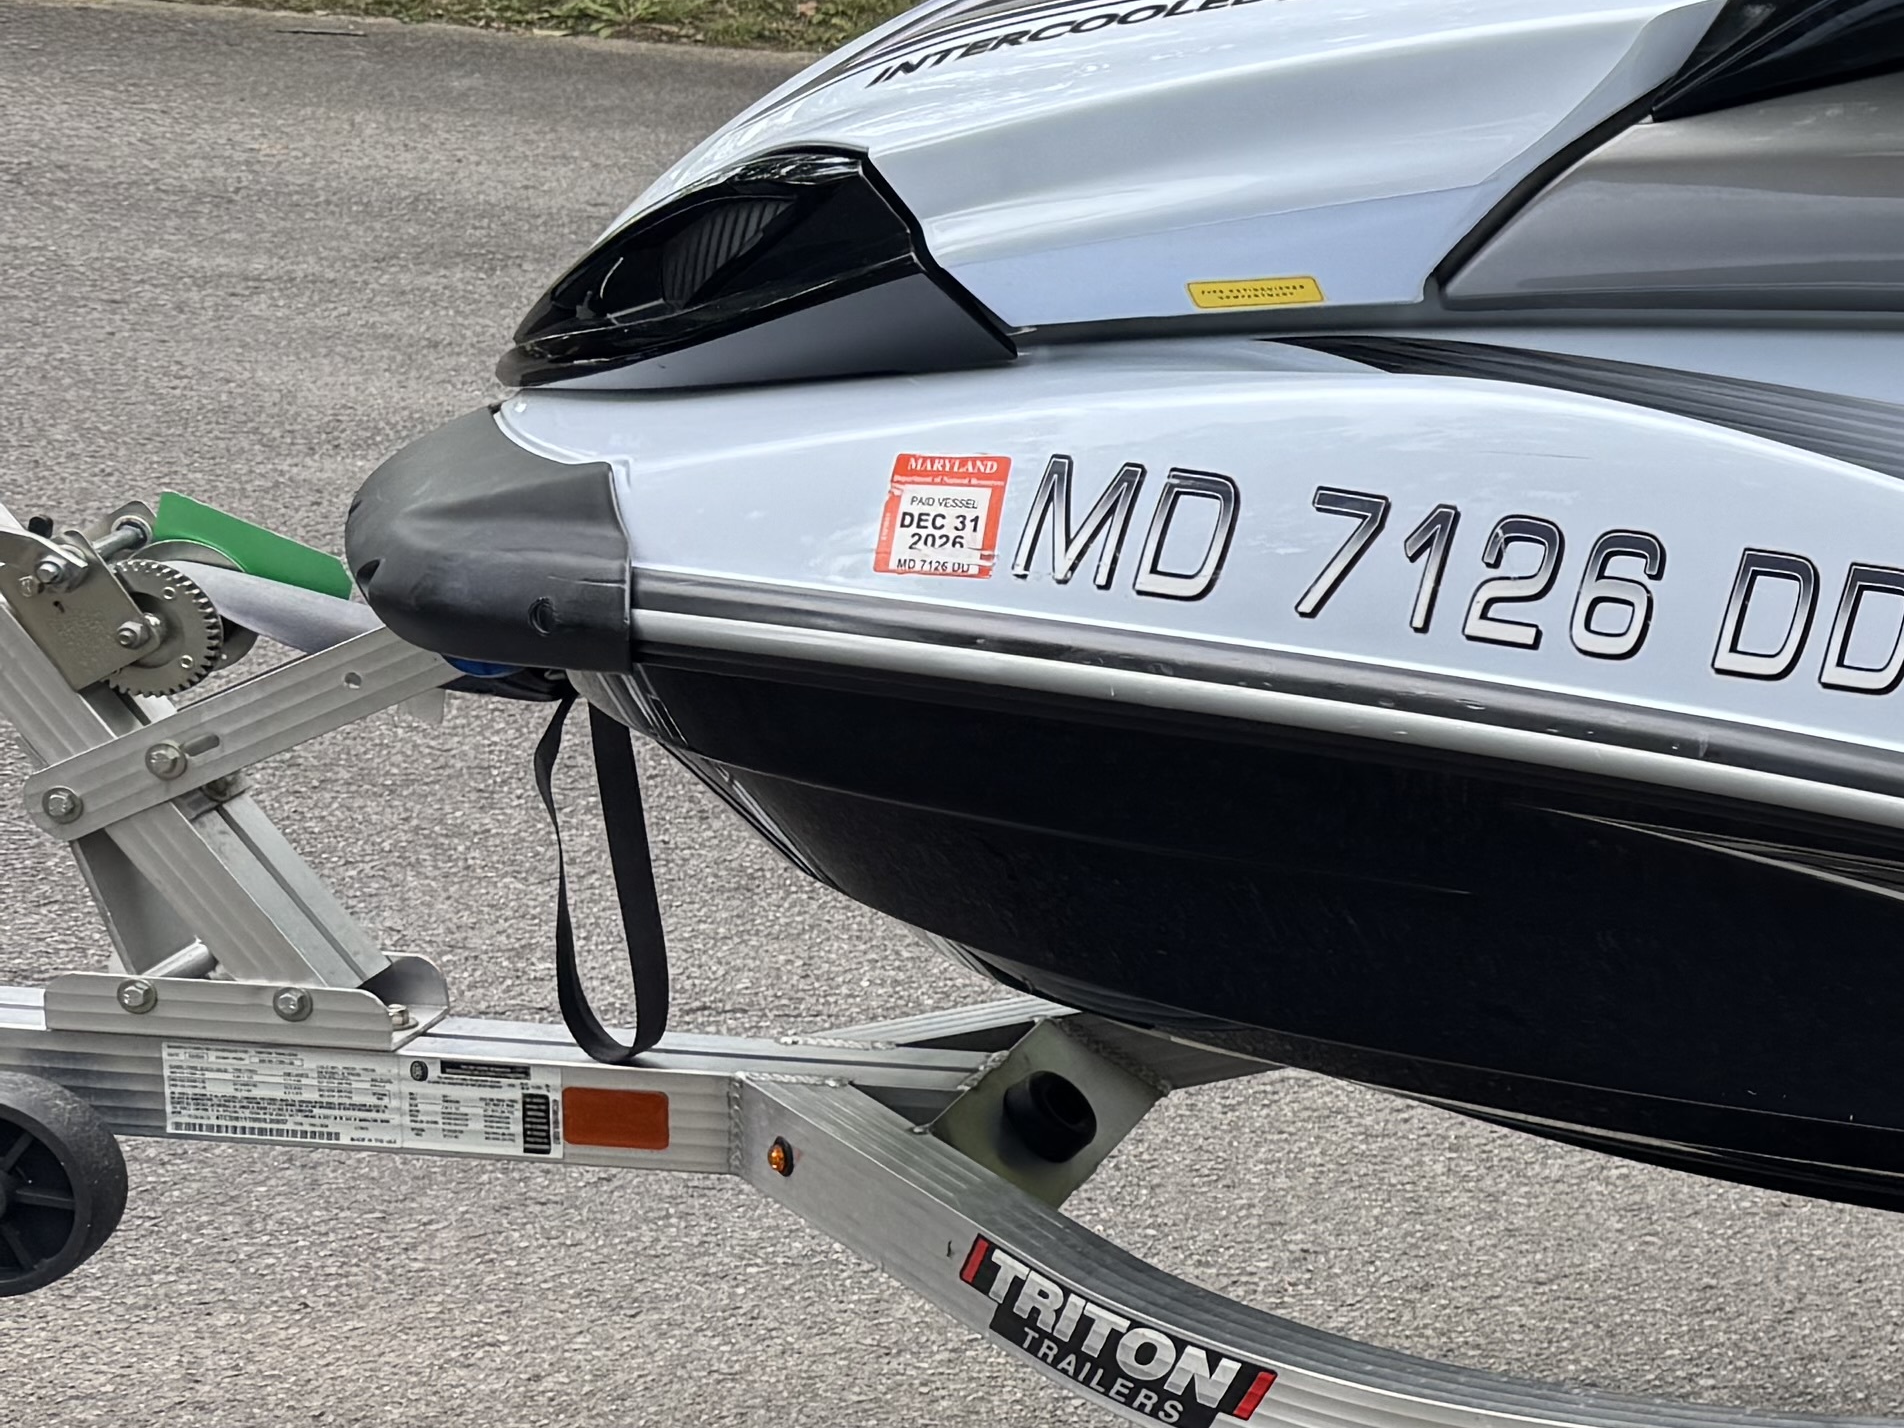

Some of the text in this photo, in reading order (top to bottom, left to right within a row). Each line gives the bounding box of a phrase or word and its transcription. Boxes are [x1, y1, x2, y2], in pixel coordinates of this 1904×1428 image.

[907, 457, 998, 473] MARYLAND
[937, 497, 978, 509] VESSEL
[900, 511, 946, 530] DEC
[954, 514, 979, 533] 31
[908, 532, 965, 549] 2026
[897, 558, 916, 570] MD
[920, 559, 949, 572] 7126
[1013, 453, 1240, 601] MD
[1294, 485, 1668, 660] 7126
[988, 1248, 1242, 1408] TRITON
[1022, 1326, 1184, 1423] TRAILERS
